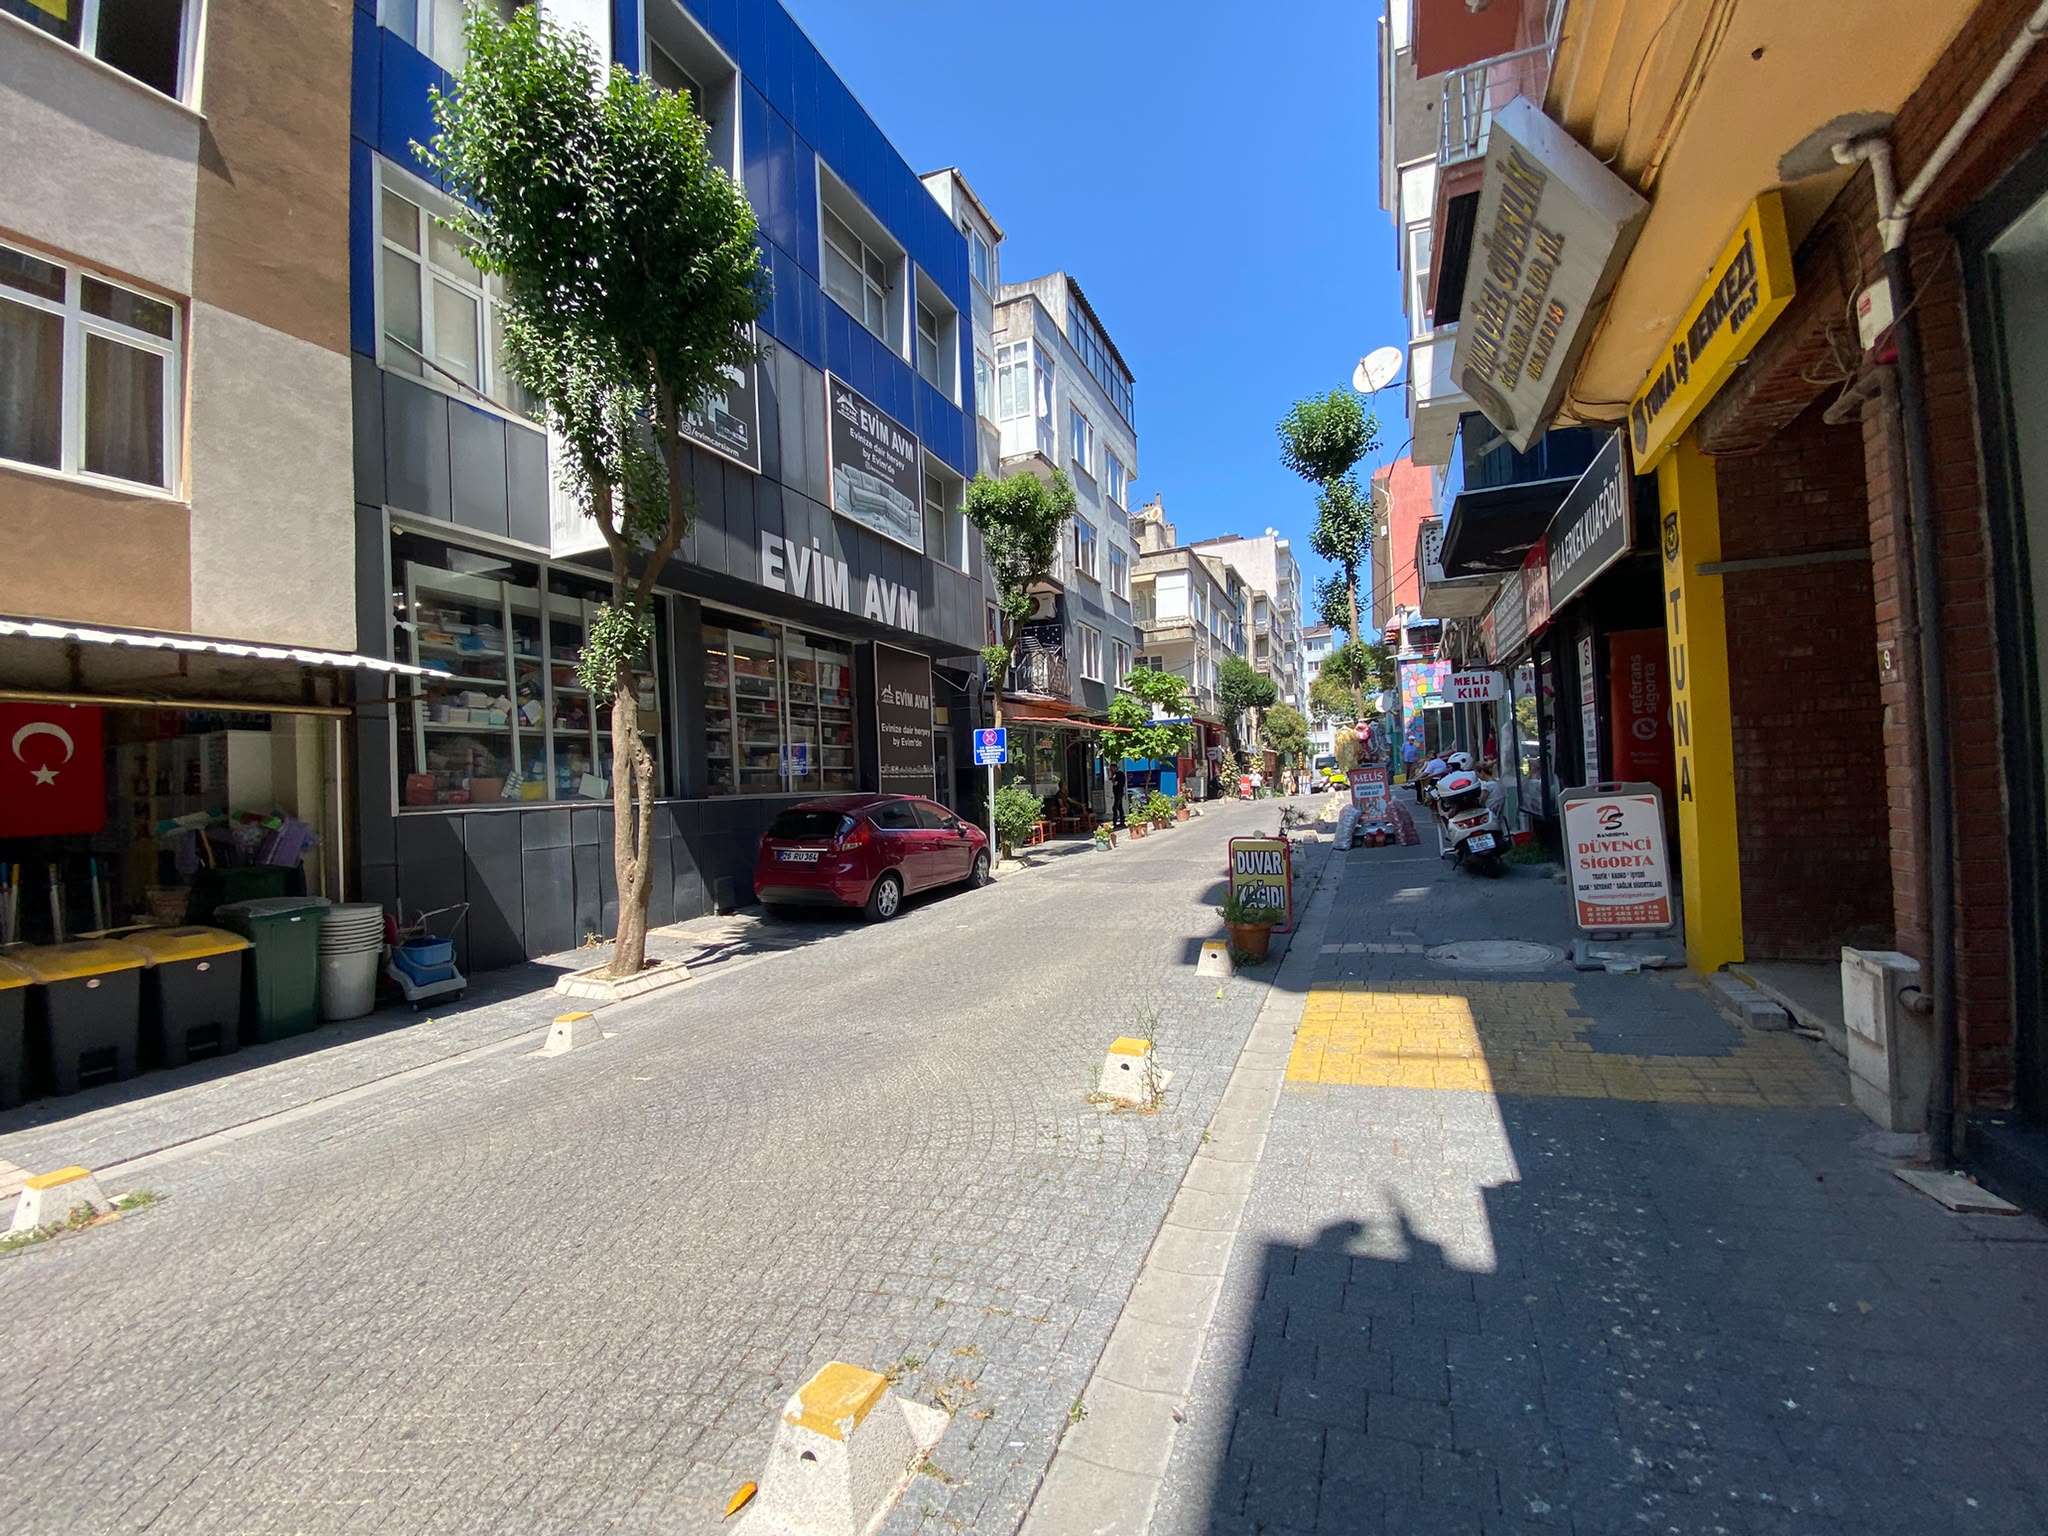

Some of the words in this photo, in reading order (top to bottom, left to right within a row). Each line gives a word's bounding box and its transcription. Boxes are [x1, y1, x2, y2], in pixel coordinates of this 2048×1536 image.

[1482, 144, 1547, 292] GÜVENLİK
[1471, 277, 1512, 341] ÖZEL
[1644, 361, 1676, 425] TUNA
[1673, 340, 1689, 386] İŞ
[1687, 227, 1757, 365] MERKEZİ
[1465, 327, 1499, 382] TUNA
[860, 408, 889, 447] EVİM
[892, 431, 914, 464] AVM
[862, 447, 871, 462] by
[1565, 516, 1585, 570] ERKEK
[1584, 463, 1623, 547] KUAFÖRÜ
[761, 530, 850, 613] EVİM
[864, 573, 920, 634] AVM
[1883, 650, 1891, 670] 9
[1453, 673, 1490, 687] MELİS
[1629, 654, 1643, 715] referans
[1643, 663, 1660, 715] sigorta
[895, 689, 914, 709] EVİM
[914, 694, 929, 710] AVM
[1458, 687, 1489, 699] KINA
[892, 737, 900, 748] by
[1353, 771, 1384, 782] MELİS
[1578, 836, 1652, 854] DÜVENCİ
[1236, 850, 1284, 875] DUVAR
[1580, 855, 1655, 870] SİGORTA
